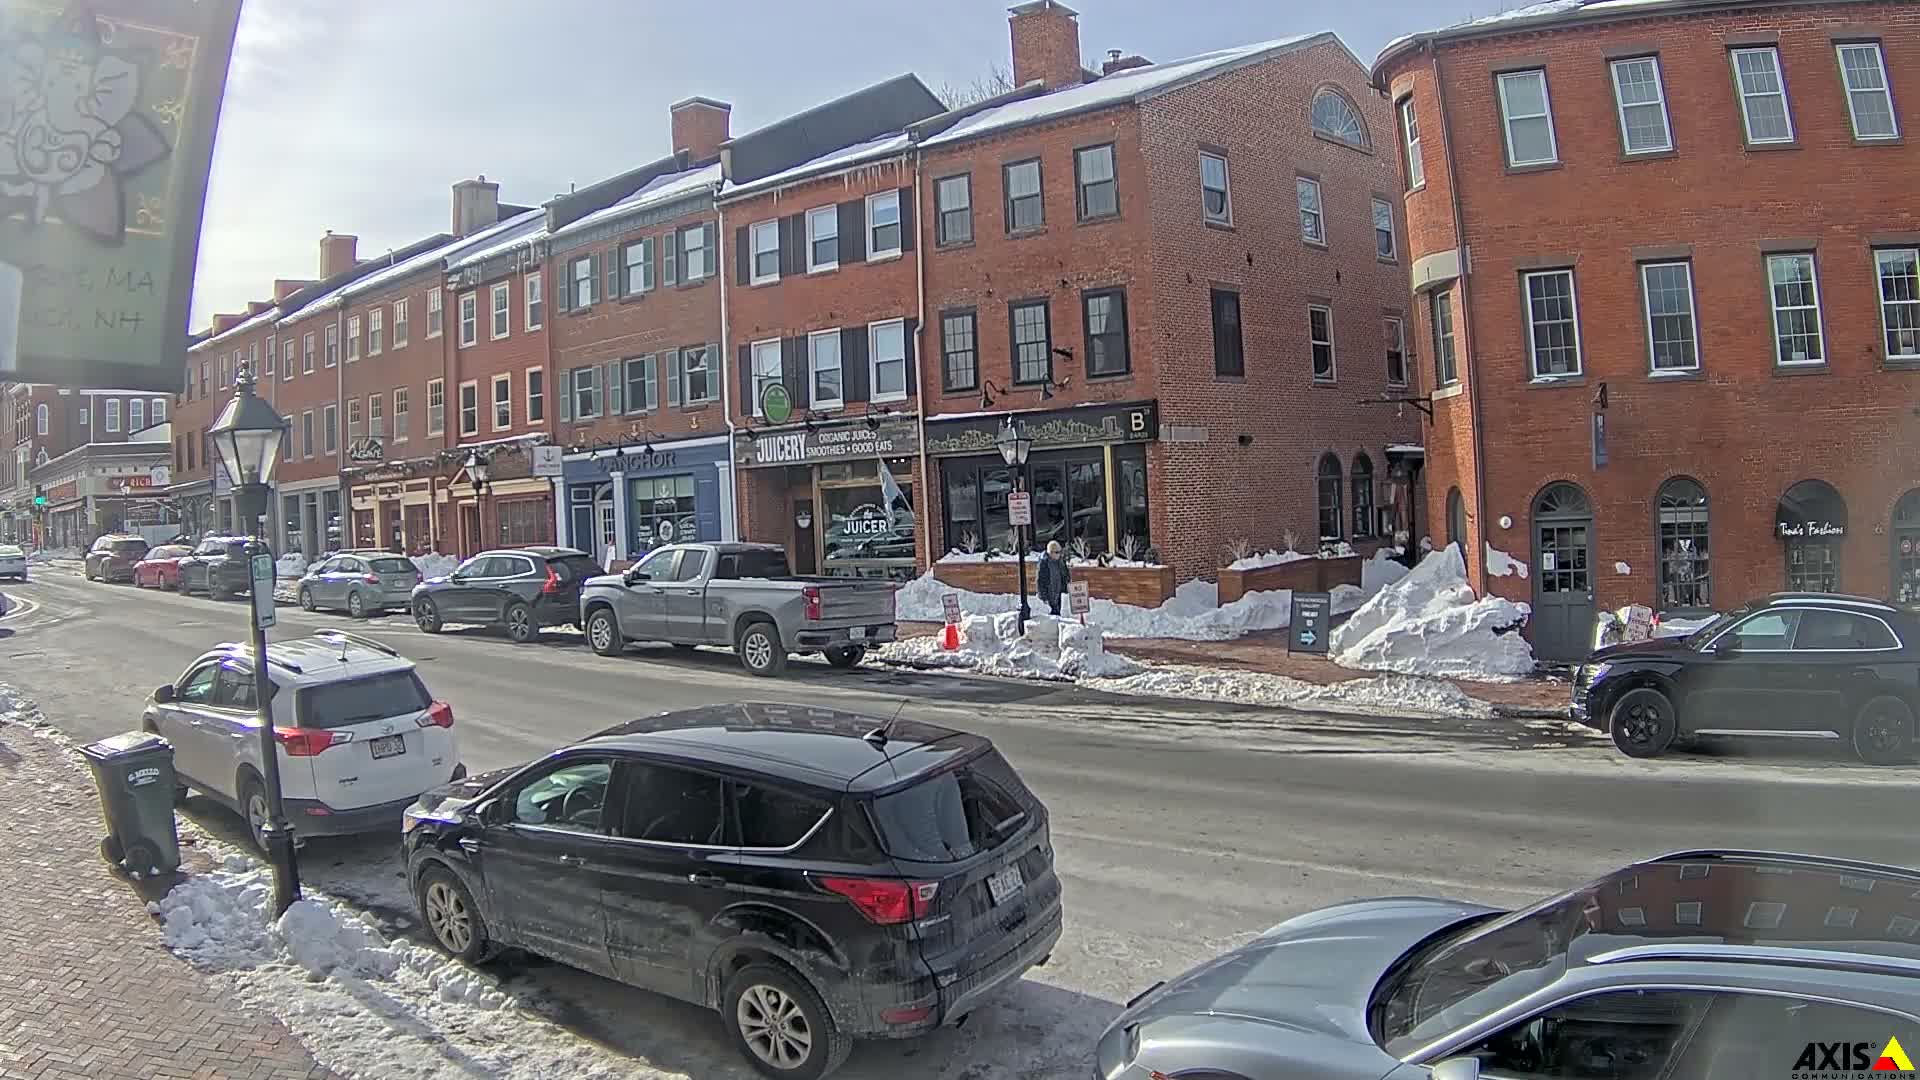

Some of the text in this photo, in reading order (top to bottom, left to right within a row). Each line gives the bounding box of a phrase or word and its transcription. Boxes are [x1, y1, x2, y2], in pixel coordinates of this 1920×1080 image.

[94, 308, 145, 333] NH
[1131, 412, 1145, 431] B
[818, 429, 877, 444] ORGANIC JUICES
[756, 433, 807, 463] JUICERY
[806, 440, 893, 457] SMOOTHIES GOOD EATS
[606, 451, 677, 472] ANCHOR
[843, 519, 888, 534] JUICER
